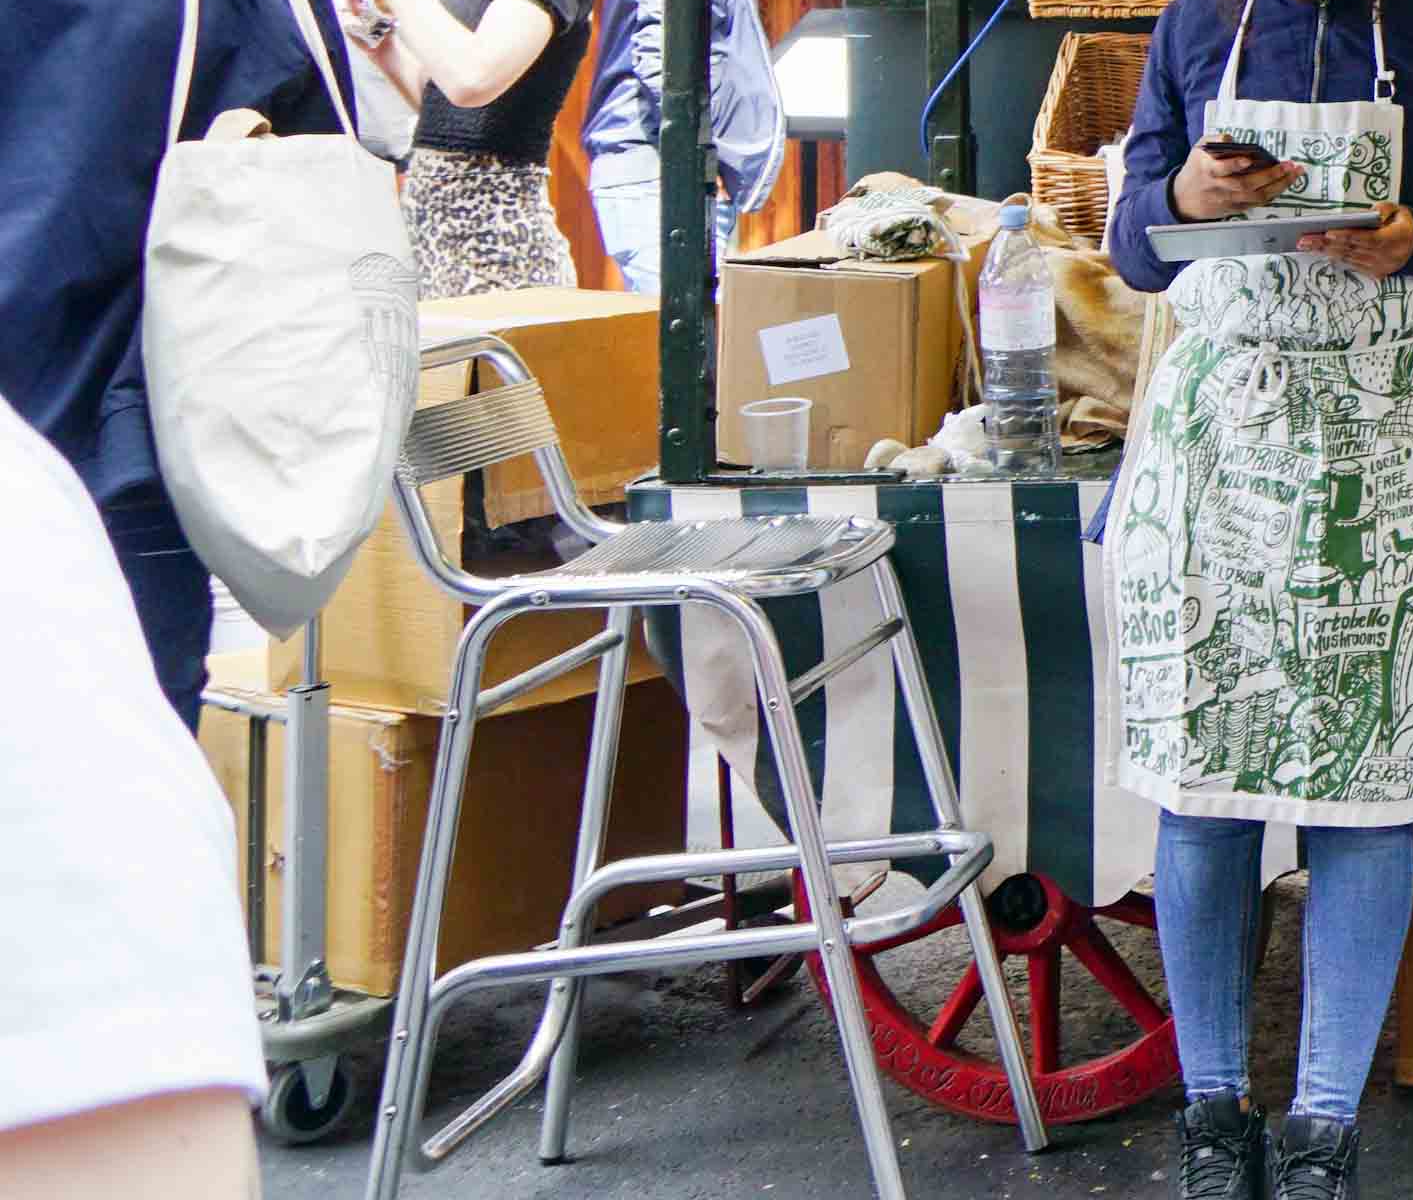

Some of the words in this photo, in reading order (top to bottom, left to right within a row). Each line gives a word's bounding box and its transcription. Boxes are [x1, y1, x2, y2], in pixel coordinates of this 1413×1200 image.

[1216, 127, 1288, 158] ROUGH
[1327, 439, 1374, 458] HUTNEY
[1370, 453, 1402, 475] LOCAL
[1375, 469, 1408, 492] FREE
[1303, 606, 1391, 638] Portobello
